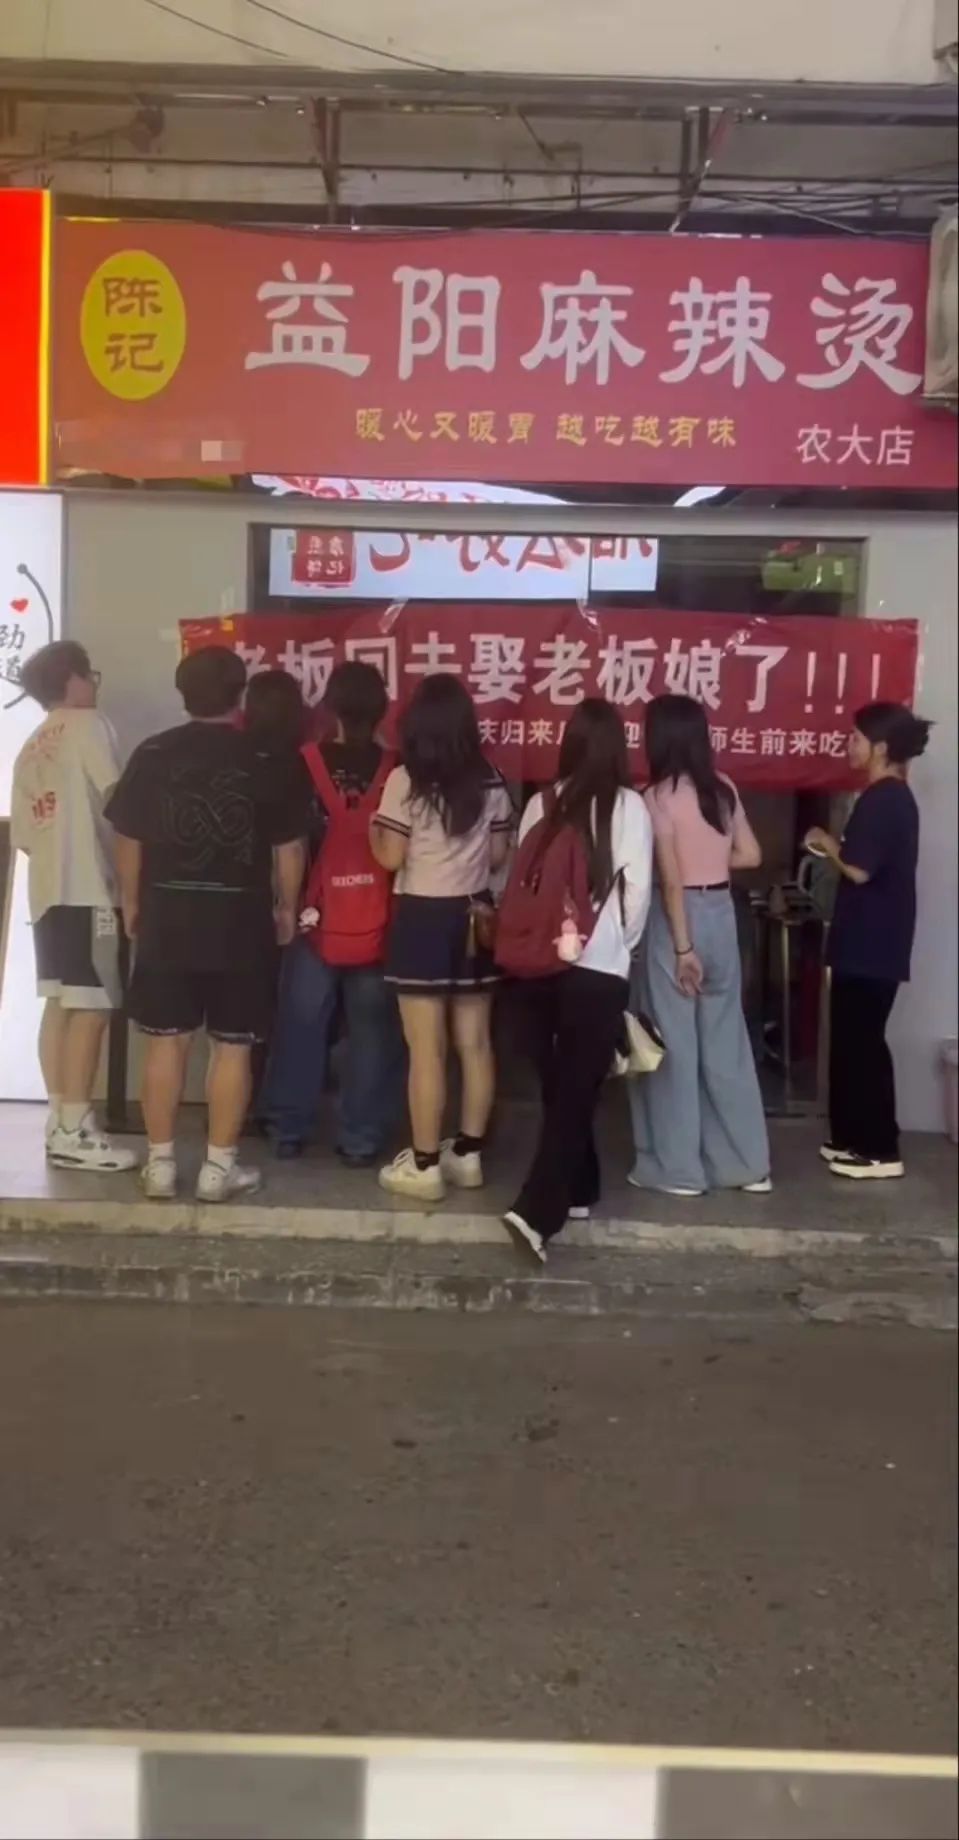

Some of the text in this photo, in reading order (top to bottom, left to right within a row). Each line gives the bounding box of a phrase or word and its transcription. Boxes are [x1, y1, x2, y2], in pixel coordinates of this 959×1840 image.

[102, 277, 164, 373] 陈记
[245, 261, 923, 394] 益阳麻辣烫
[356, 408, 737, 449] 暖心又暖胃 越吃越有味
[796, 424, 915, 466] 农大店
